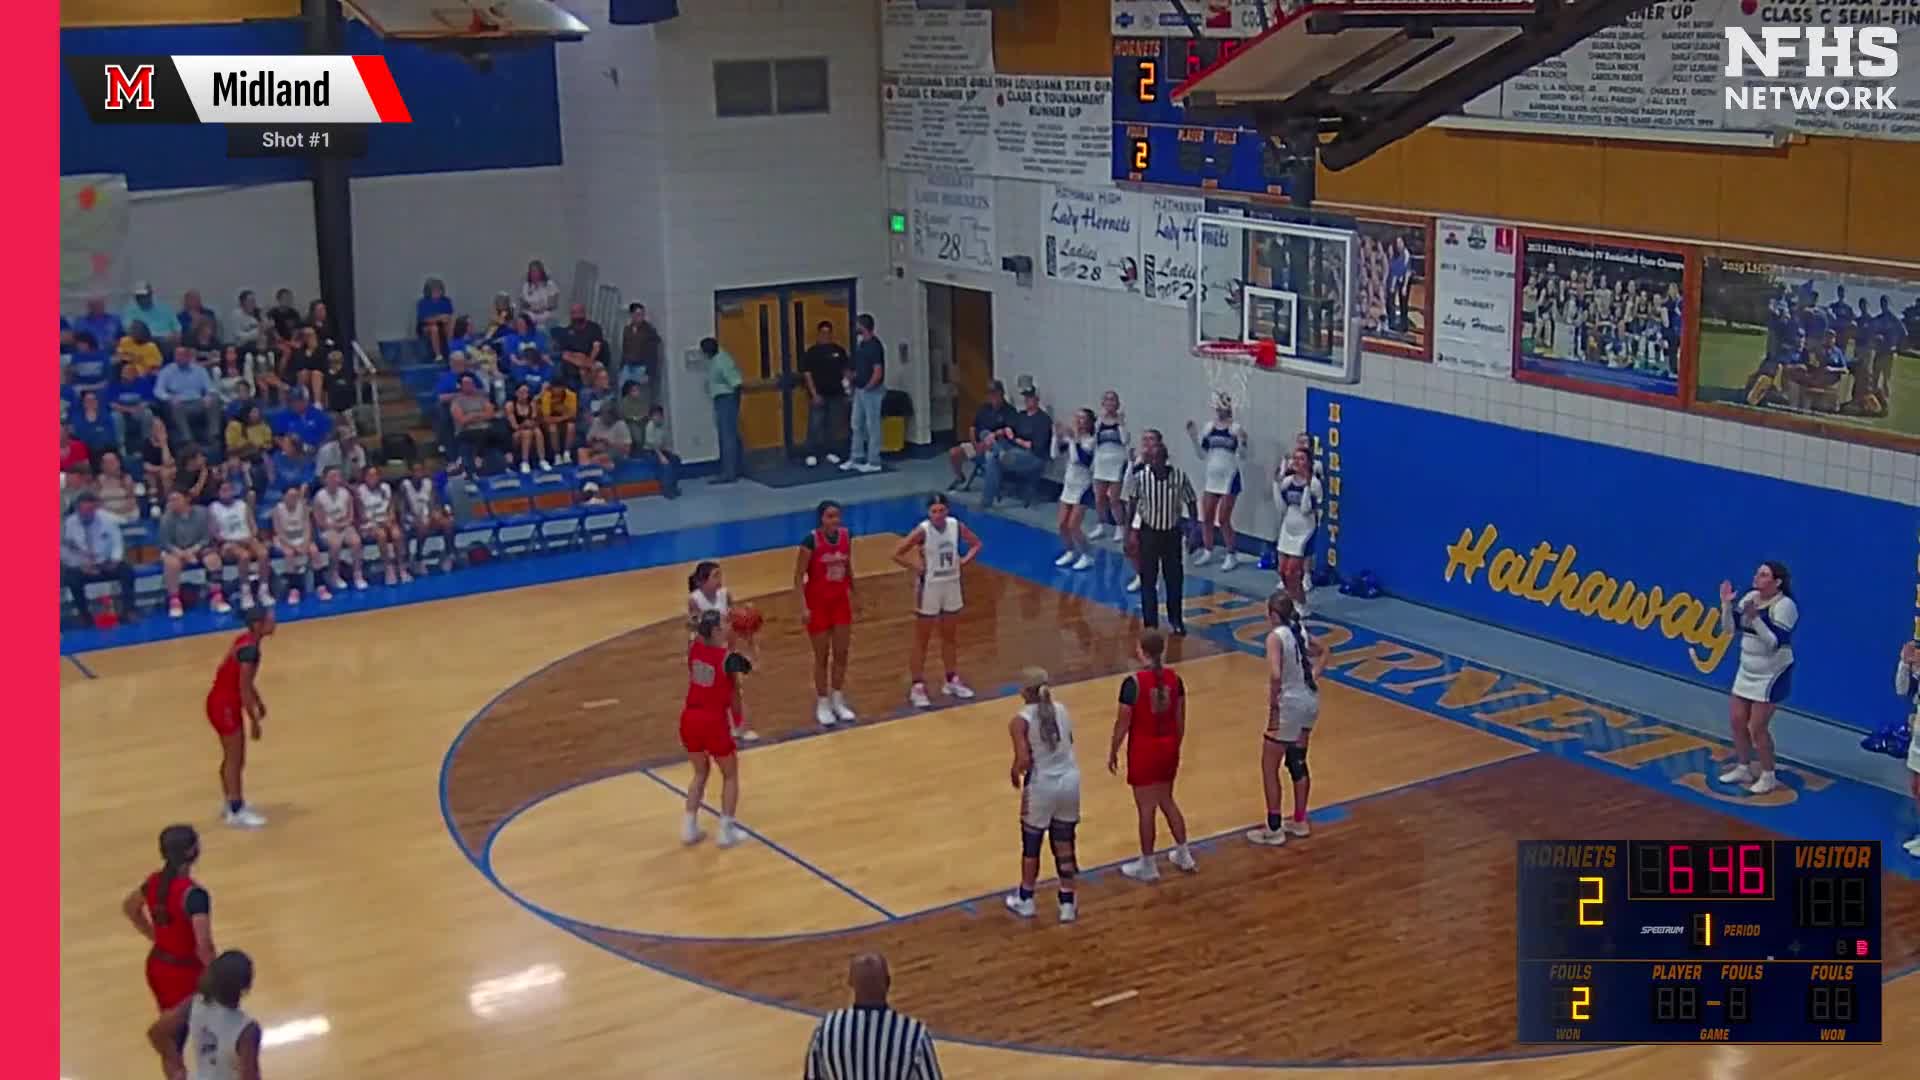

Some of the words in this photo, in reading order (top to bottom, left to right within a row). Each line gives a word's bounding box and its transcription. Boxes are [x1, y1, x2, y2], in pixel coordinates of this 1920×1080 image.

[1671, 4, 1693, 20] UP
[1761, 6, 1813, 23] CLASS
[1820, 8, 1832, 24] C
[1114, 39, 1161, 57] HORNETS
[1014, 79, 1062, 91] LOUISIANA
[1065, 80, 1091, 91] STATE
[1138, 61, 1156, 101] 2
[965, 89, 977, 101] UP
[1007, 91, 1033, 103] CLASS
[1035, 92, 1043, 103] C
[1043, 93, 1105, 105] TOURNAMENT
[1028, 104, 1065, 116] RUNNER
[1067, 105, 1082, 117] UP
[1135, 142, 1147, 169] 2
[1050, 201, 1079, 234] Lady
[1081, 208, 1131, 233] Hornets
[1182, 217, 1230, 248] Hrnets
[938, 231, 961, 262] 28
[1078, 264, 1102, 281] 28
[1328, 402, 1341, 567] HORNETS
[1444, 526, 1735, 674] Hathaway
[1182, 588, 1836, 812] HORNETS
